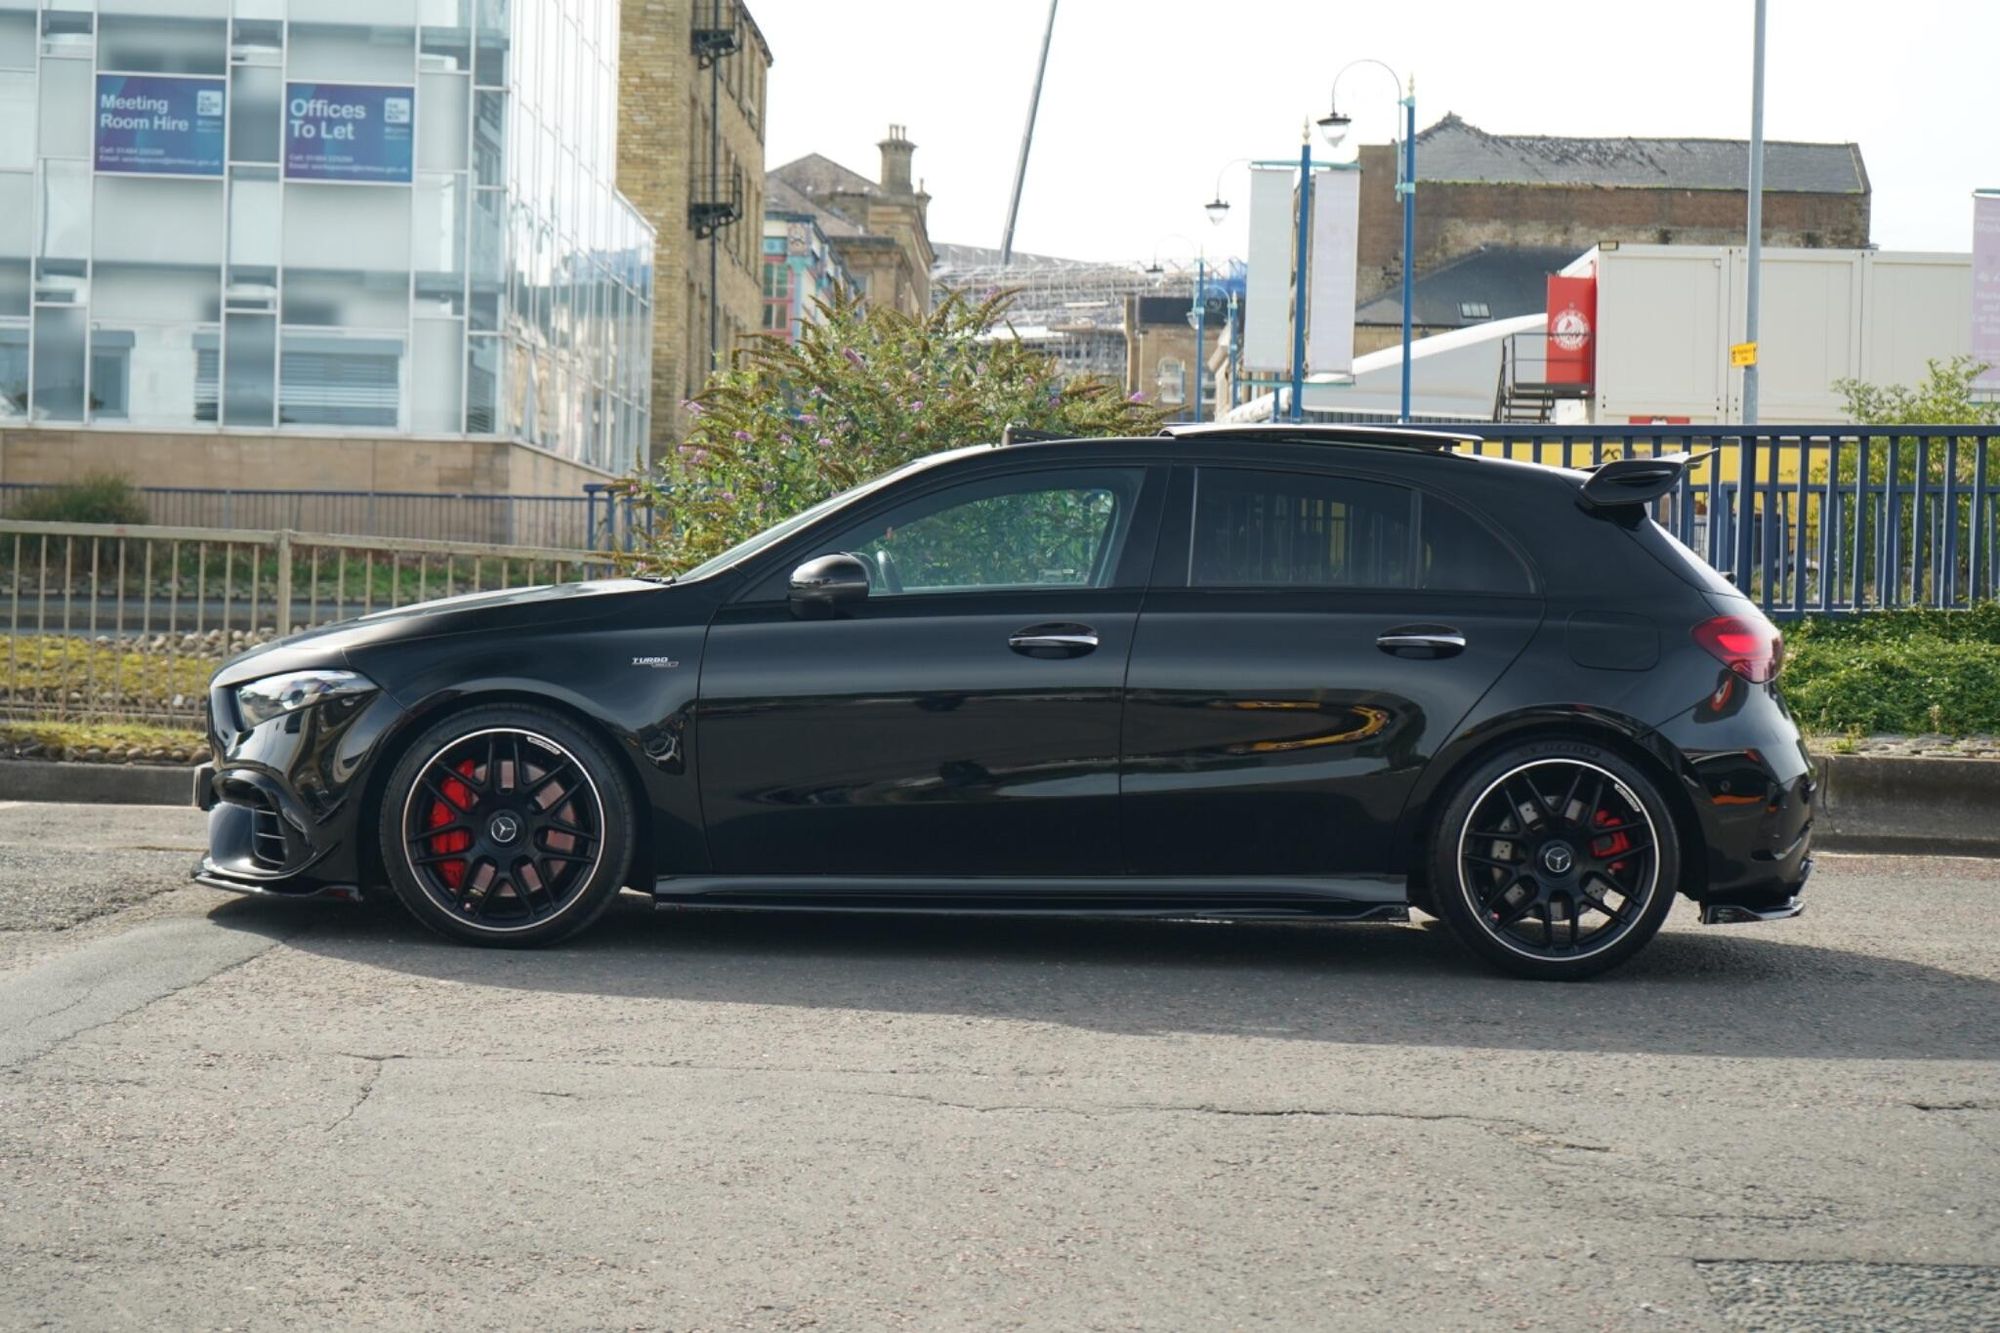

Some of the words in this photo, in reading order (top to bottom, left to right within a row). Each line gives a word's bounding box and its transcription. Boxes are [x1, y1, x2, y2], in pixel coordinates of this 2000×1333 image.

[100, 94, 168, 114] Meeting
[289, 98, 366, 119] Offices
[100, 113, 149, 130] Room
[153, 115, 189, 132] Hire
[289, 119, 316, 139] To
[320, 121, 355, 140] Let
[632, 656, 668, 664] TURBO
